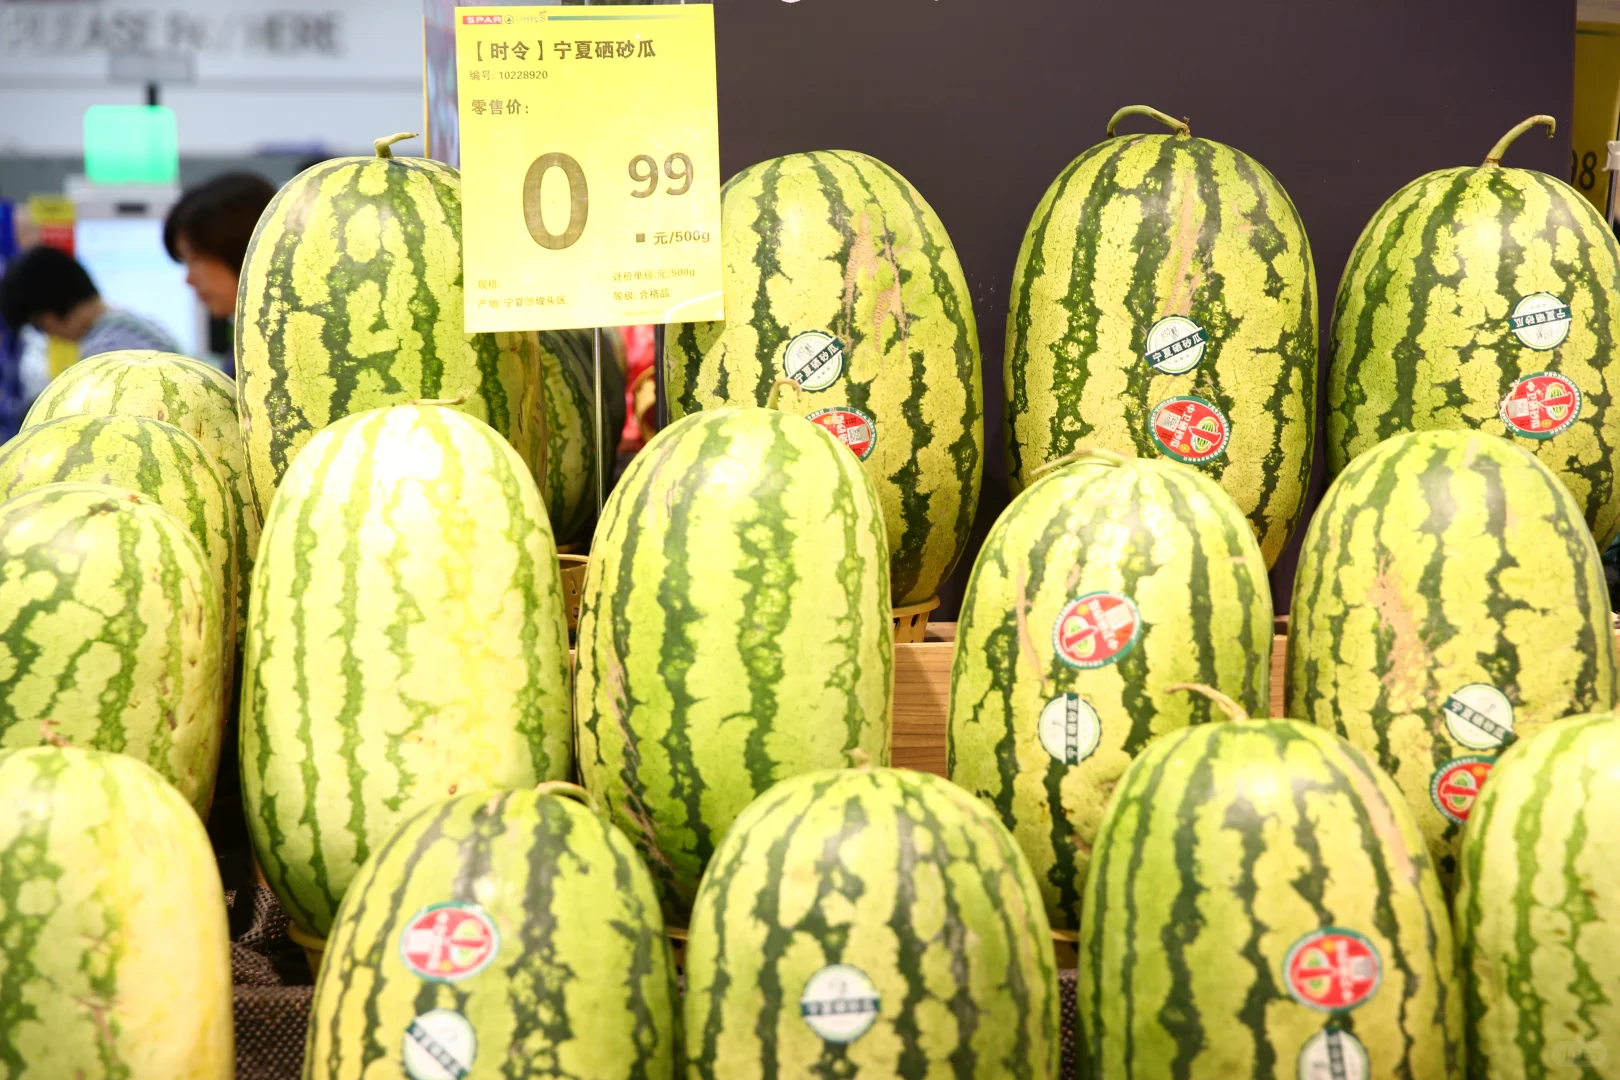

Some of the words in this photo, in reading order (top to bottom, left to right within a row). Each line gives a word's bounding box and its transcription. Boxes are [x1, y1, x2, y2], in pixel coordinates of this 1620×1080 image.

[466, 16, 502, 24] SPAR
[499, 70, 548, 80] 10228920
[523, 151, 589, 250] 0
[628, 152, 694, 199] 99
[653, 230, 711, 245] 元/500g
[640, 287, 670, 300] 合格品
[504, 295, 566, 308] 宁夏沙坡头区
[1152, 333, 1204, 363] 宁夏硒砂瓜
